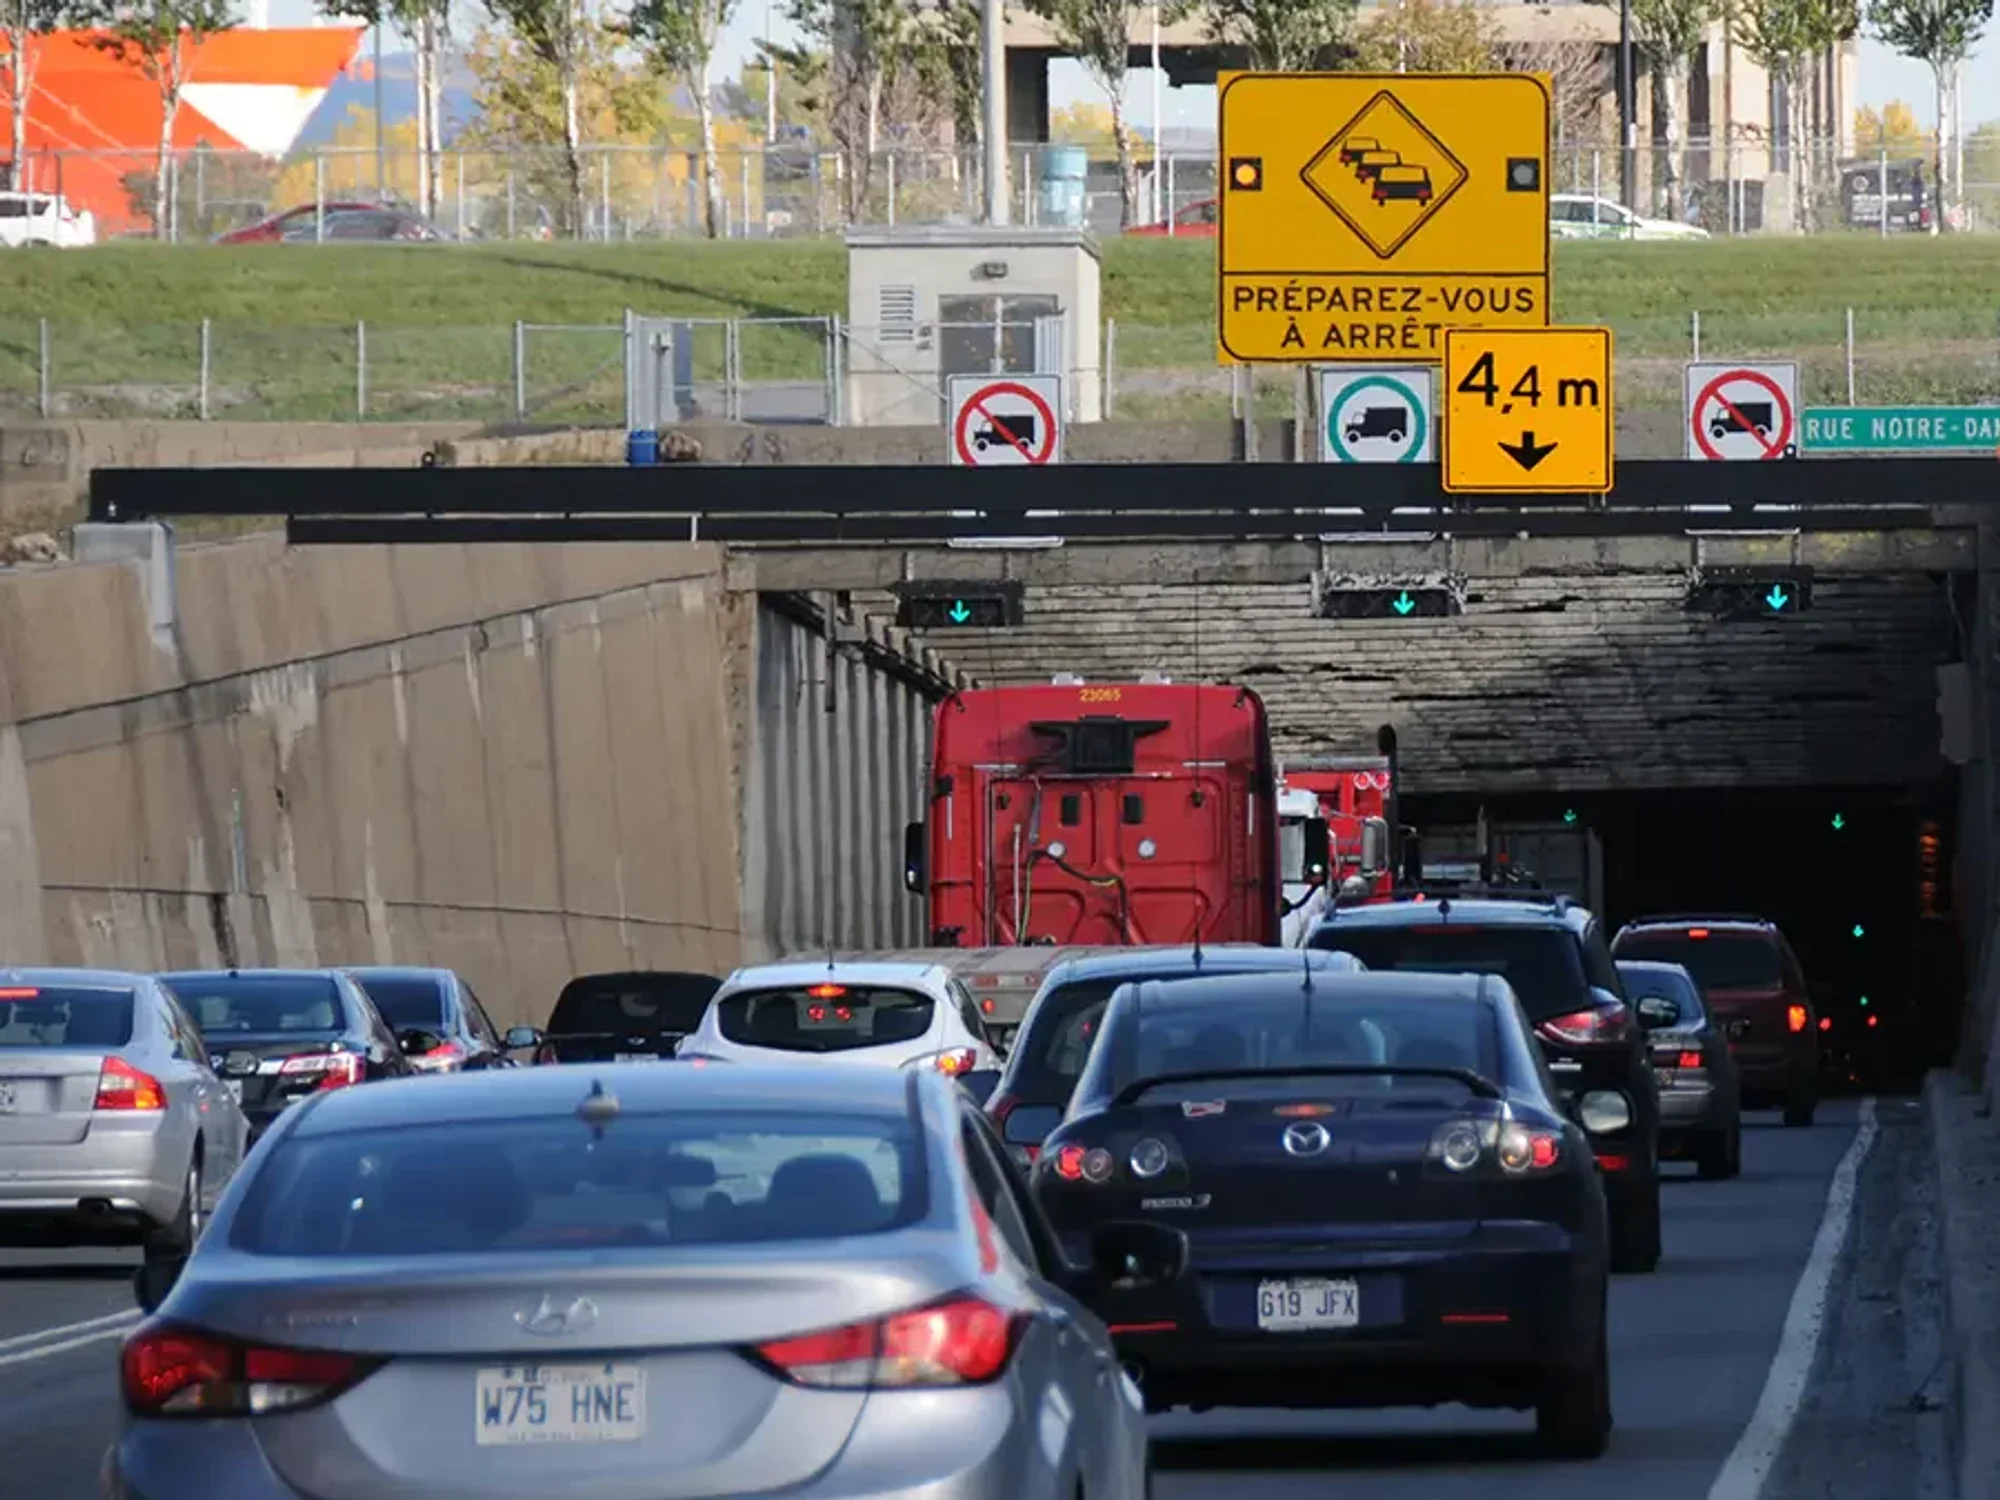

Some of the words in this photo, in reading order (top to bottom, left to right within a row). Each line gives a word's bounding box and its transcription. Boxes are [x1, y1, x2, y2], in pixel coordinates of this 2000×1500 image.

[1233, 280, 1534, 313] PRÉPAREZ-VOUS
[1281, 317, 1305, 349] À
[1322, 318, 1484, 349] ARRÊT
[1558, 378, 1598, 406] m
[1807, 417, 1854, 440] RUE
[1316, 1289, 1355, 1316] JFX
[484, 1386, 546, 1425] W75
[572, 1383, 634, 1424] HNE
